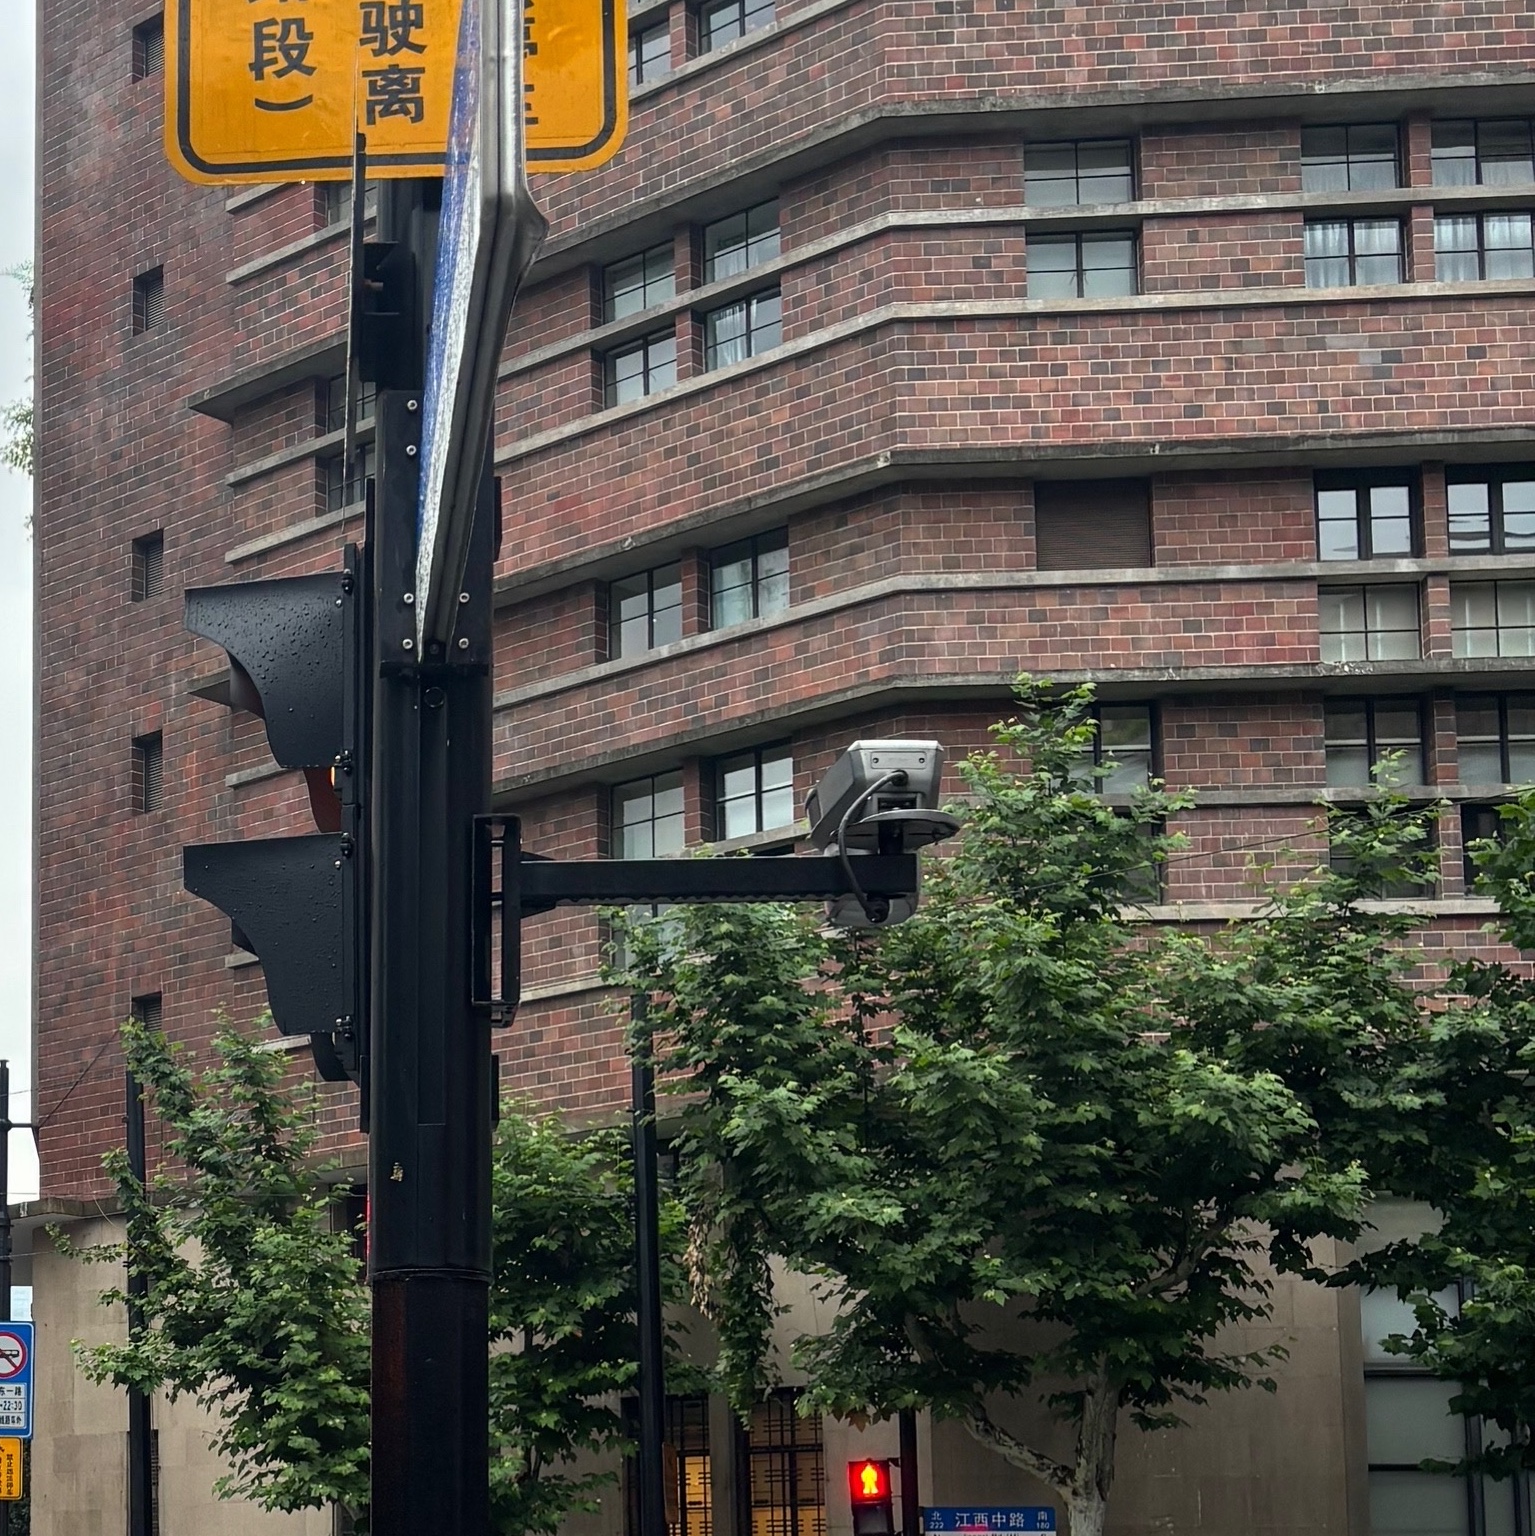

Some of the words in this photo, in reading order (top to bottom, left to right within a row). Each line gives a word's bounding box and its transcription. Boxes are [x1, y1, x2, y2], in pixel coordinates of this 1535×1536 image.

[359, 0, 428, 126] 驶离
[931, 1511, 942, 1521] 北
[955, 1511, 1024, 1528] 江西中路
[929, 1521, 944, 1529] 222
